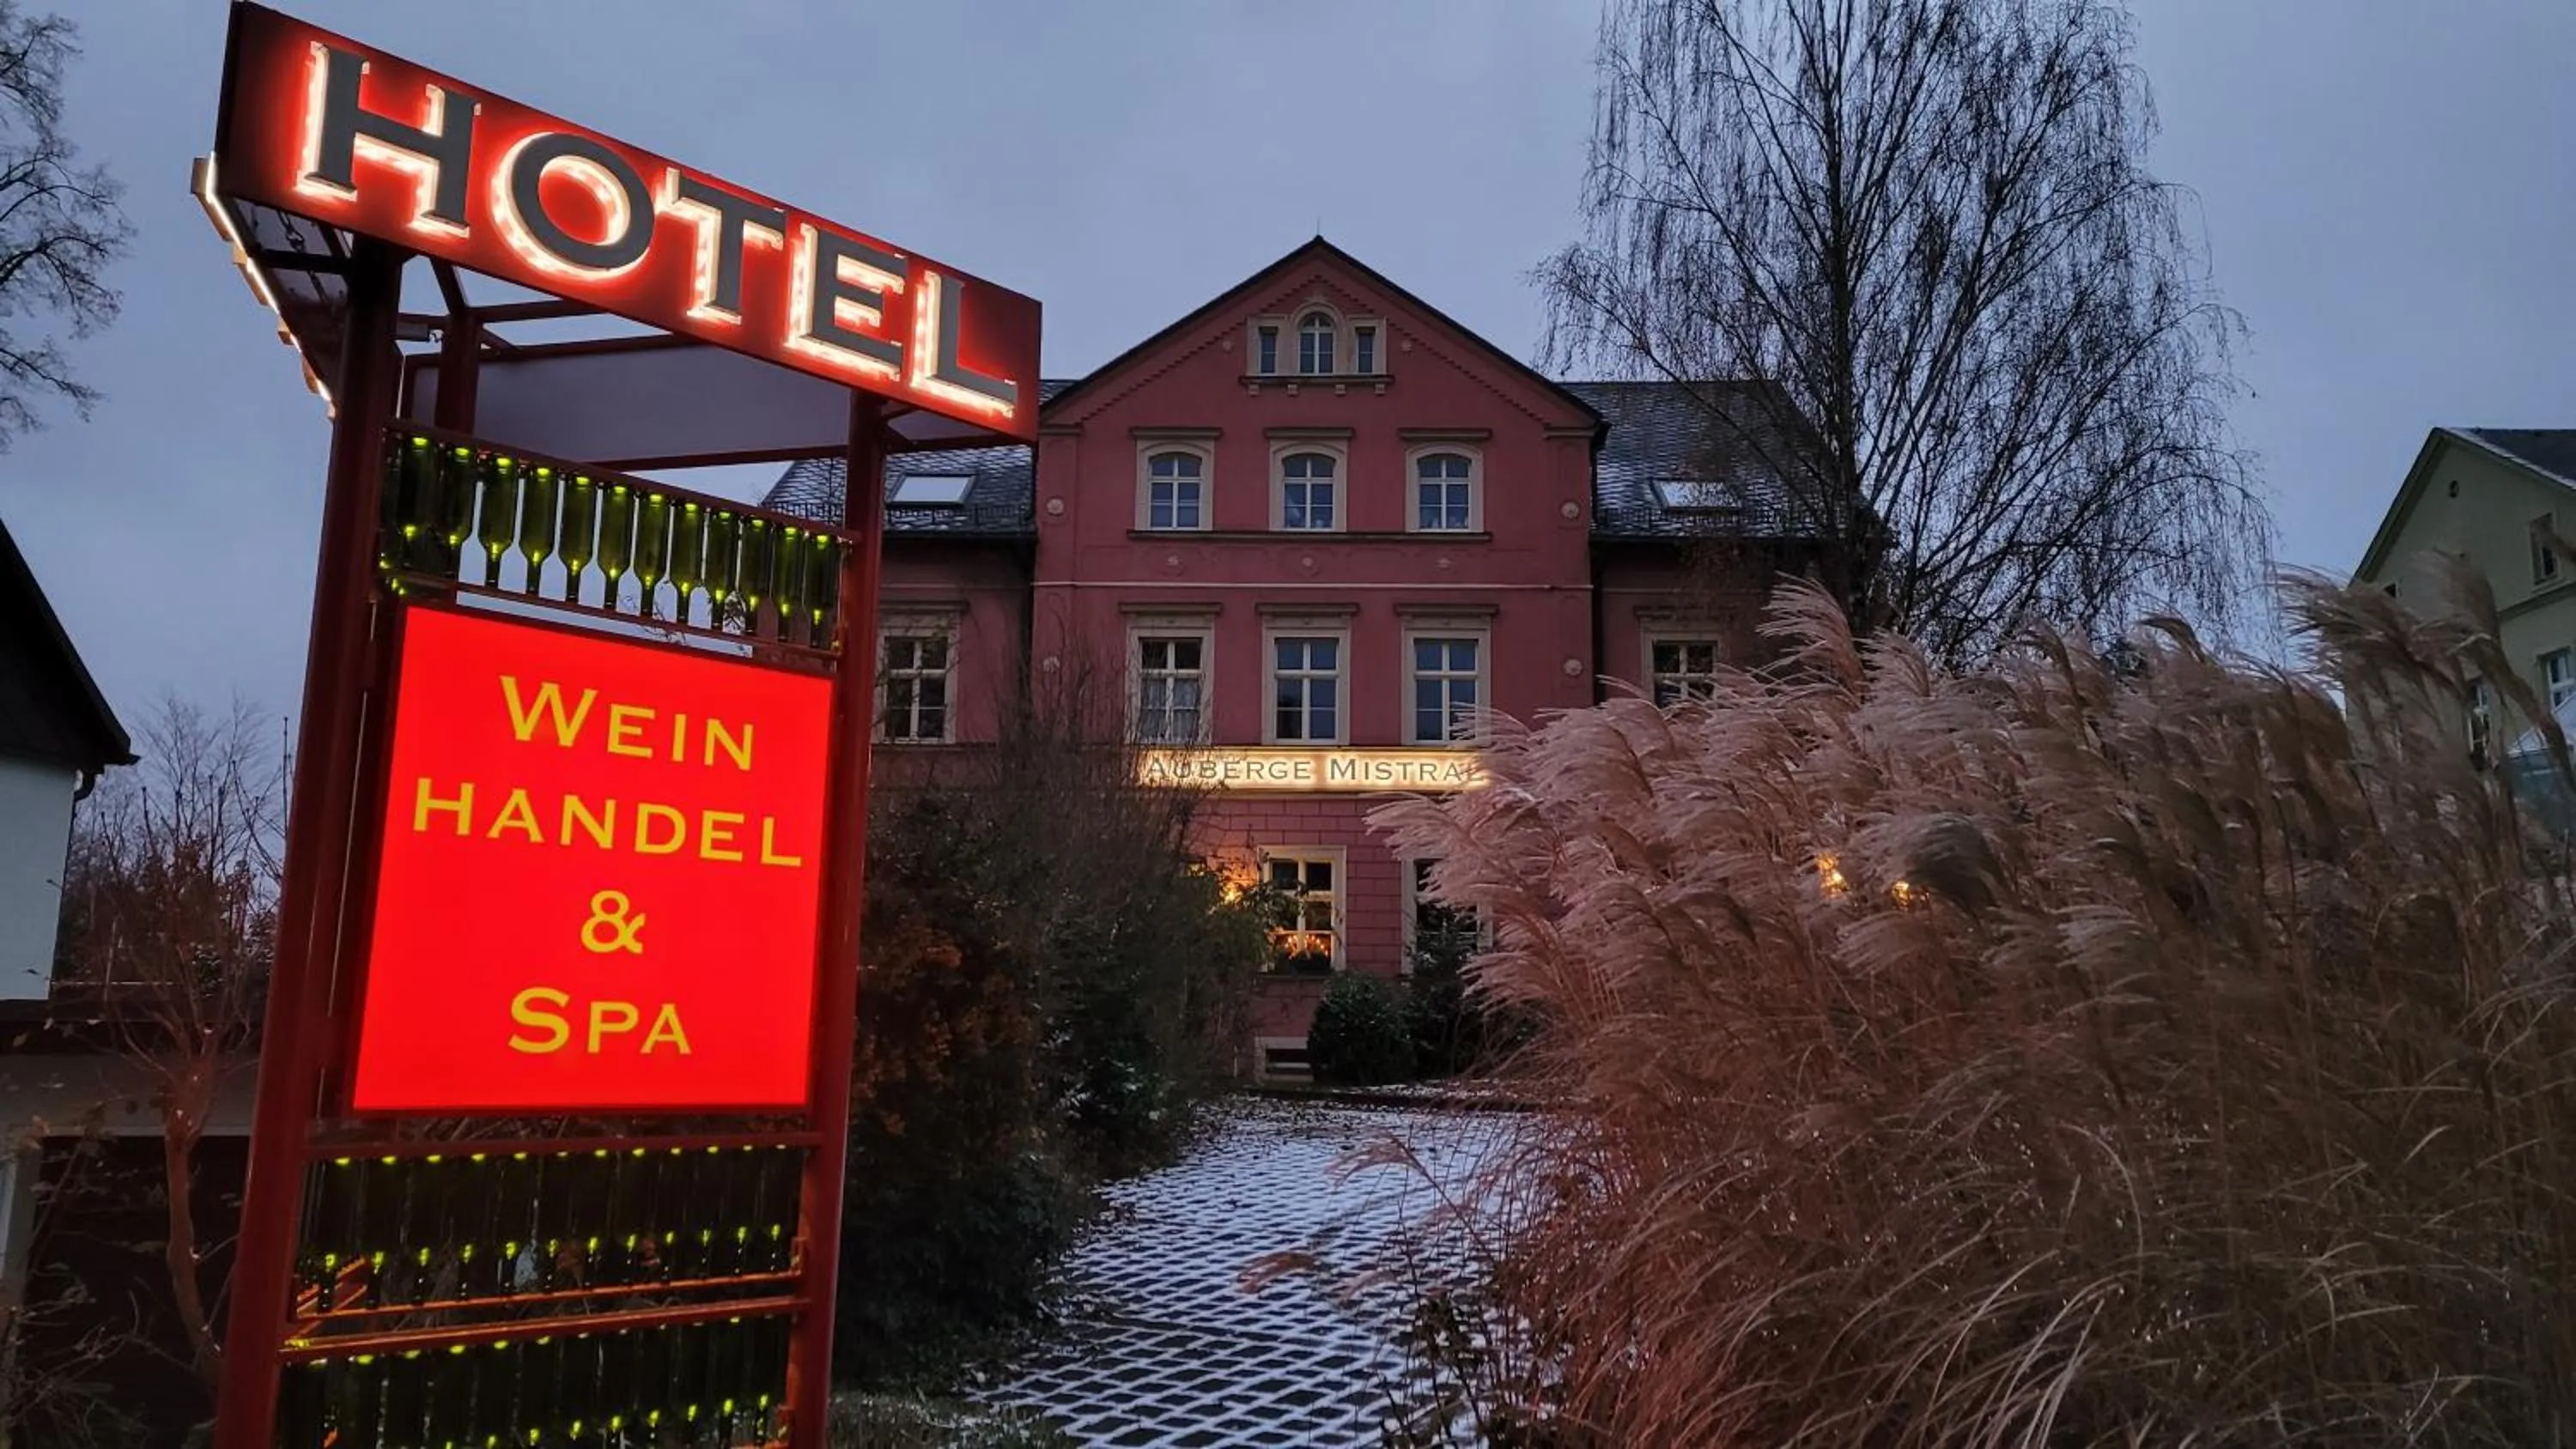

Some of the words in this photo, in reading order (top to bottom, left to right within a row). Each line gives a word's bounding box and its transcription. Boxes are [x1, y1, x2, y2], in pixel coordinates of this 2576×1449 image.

[295, 41, 1017, 417] HOTEL
[500, 675, 754, 771] WEIN
[1145, 757, 1311, 780] AUBERGE
[413, 778, 802, 867] HANDEL
[580, 889, 646, 954] &
[508, 986, 691, 1054] SPA
